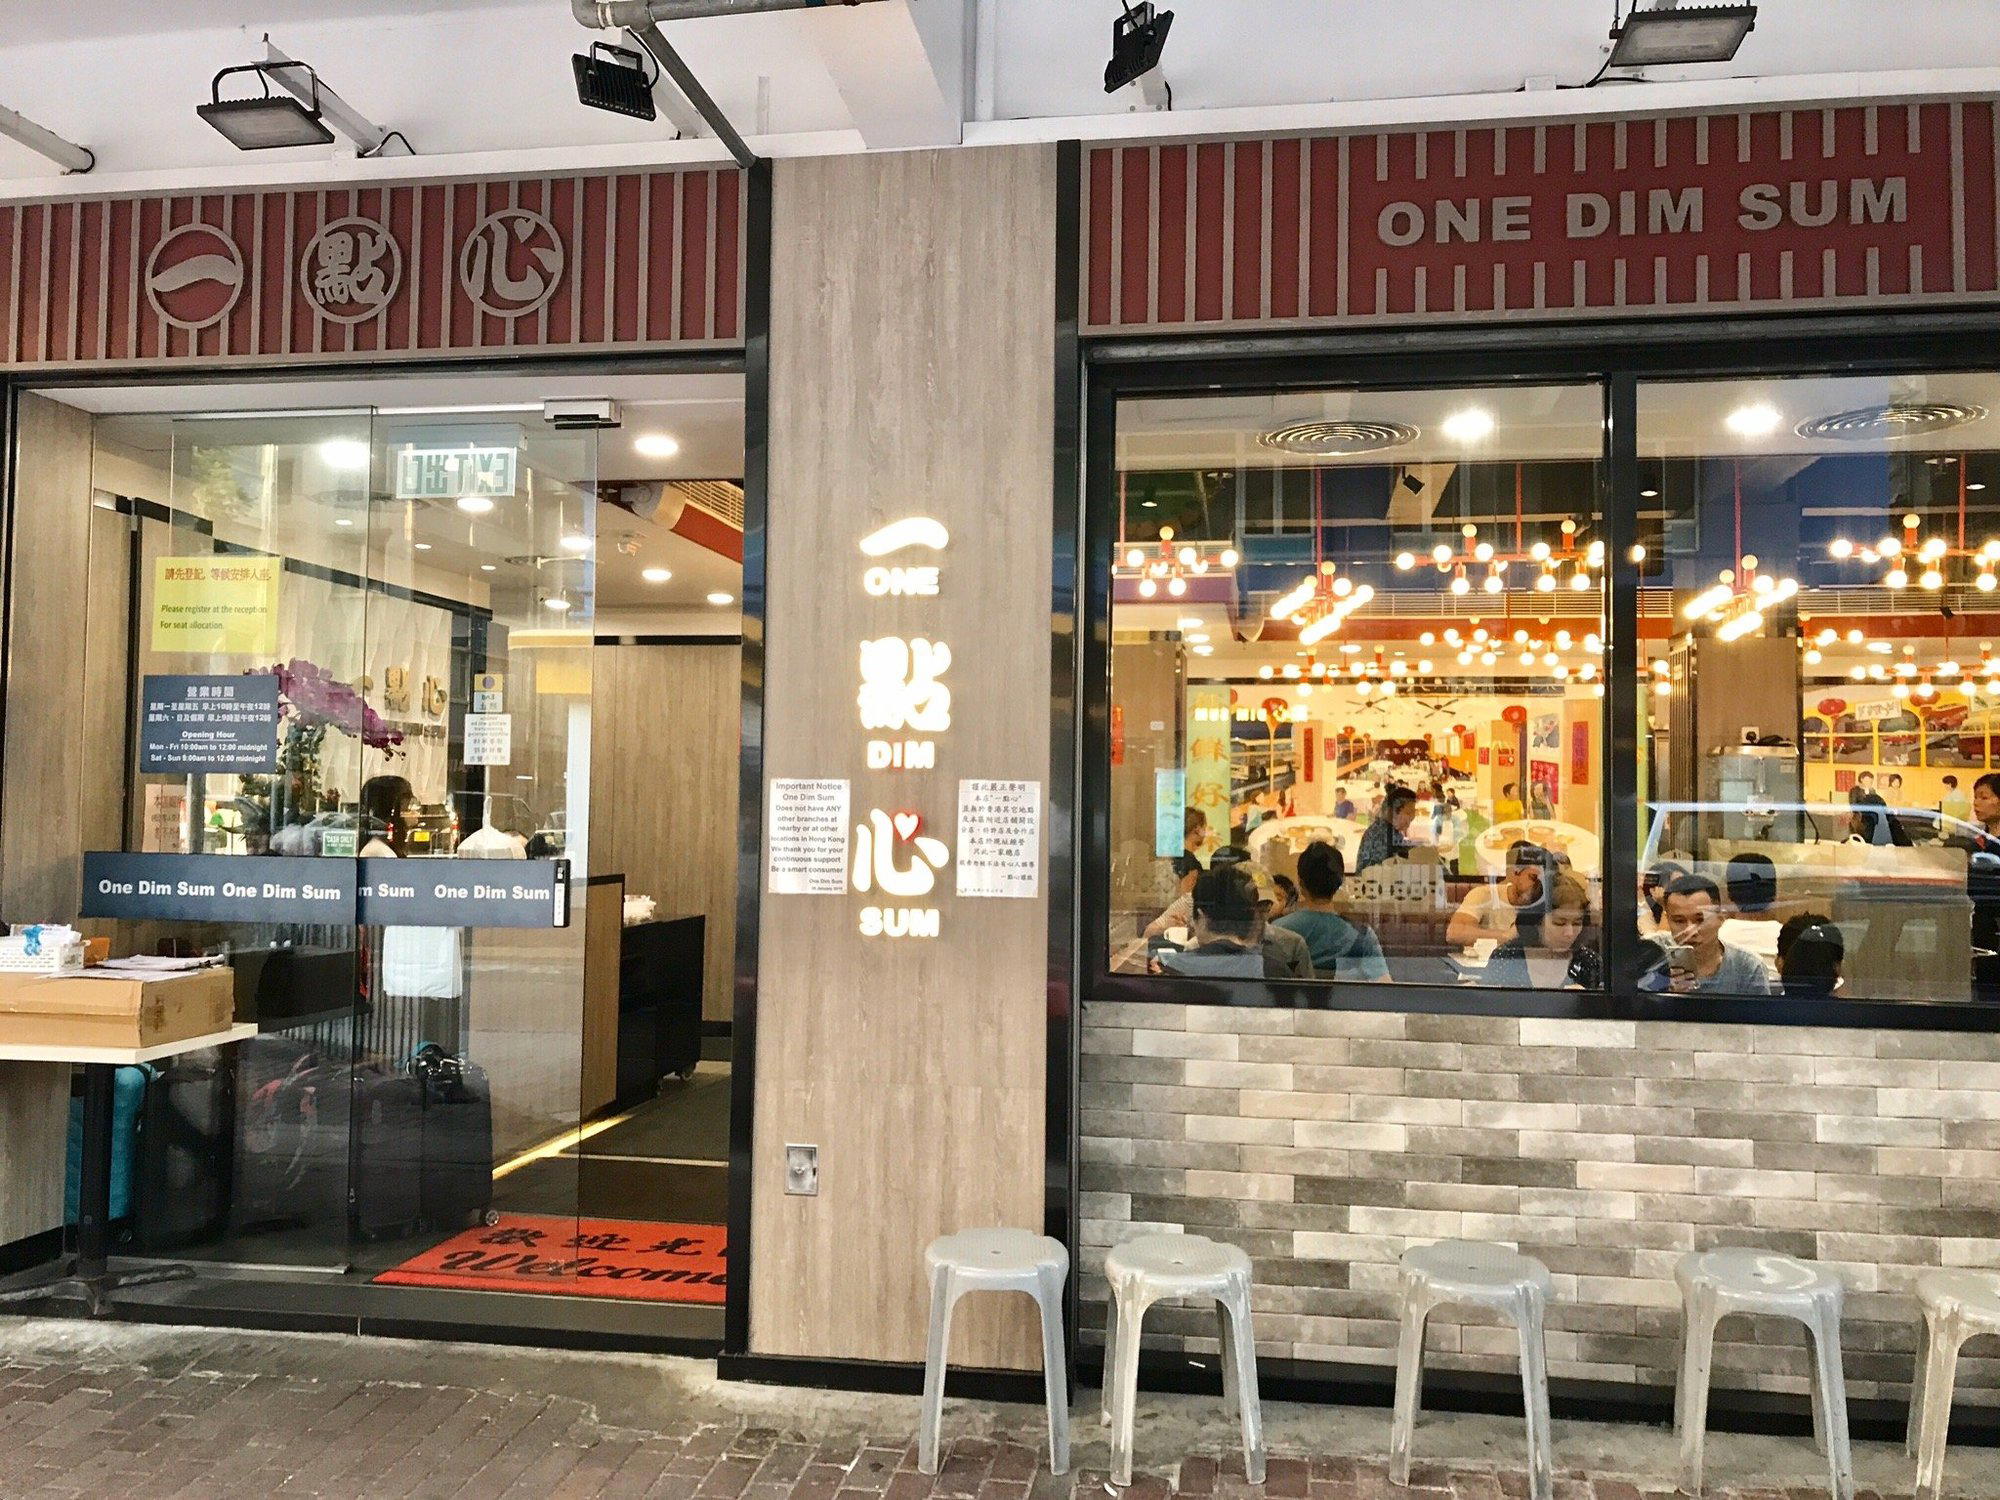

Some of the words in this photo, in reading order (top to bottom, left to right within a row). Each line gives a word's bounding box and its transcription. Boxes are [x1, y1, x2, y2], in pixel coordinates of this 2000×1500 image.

[1377, 196, 1531, 246] ONE
[1567, 188, 1703, 239] DIM
[1739, 176, 1907, 232] SUM
[151, 217, 560, 305] 一點心
[863, 566, 940, 596] ONE
[161, 605, 184, 613] Please
[185, 605, 211, 615] register
[221, 605, 233, 613] the
[160, 621, 172, 629] For
[173, 621, 188, 629] seat
[186, 685, 235, 698] 營業時間
[181, 730, 215, 740] Opening
[216, 730, 236, 739] Hour
[149, 743, 164, 751] Mon
[218, 743, 237, 751] 12:00
[237, 743, 268, 753] midnight
[150, 754, 162, 762] Sat
[167, 754, 181, 762] Sun
[216, 754, 235, 762] 12:00
[235, 754, 267, 764] midnight
[866, 740, 936, 769] DIM
[775, 783, 815, 791] Important
[782, 793, 798, 801] One
[800, 793, 816, 801] Dim
[817, 793, 835, 801] Sum
[777, 825, 801, 833] nearby
[808, 836, 826, 844] Hong
[851, 808, 950, 897] 心
[813, 856, 841, 864] support
[808, 866, 843, 874] consumer
[98, 879, 133, 894] One
[138, 880, 171, 896] Dim
[177, 881, 215, 896] Sum
[222, 882, 257, 897] One
[262, 883, 297, 899] Dim
[301, 884, 342, 900] Sum
[377, 883, 415, 898] Sum
[434, 884, 469, 899] One
[473, 885, 507, 900] Dim
[511, 885, 550, 900] Sum
[859, 907, 940, 937] SUM
